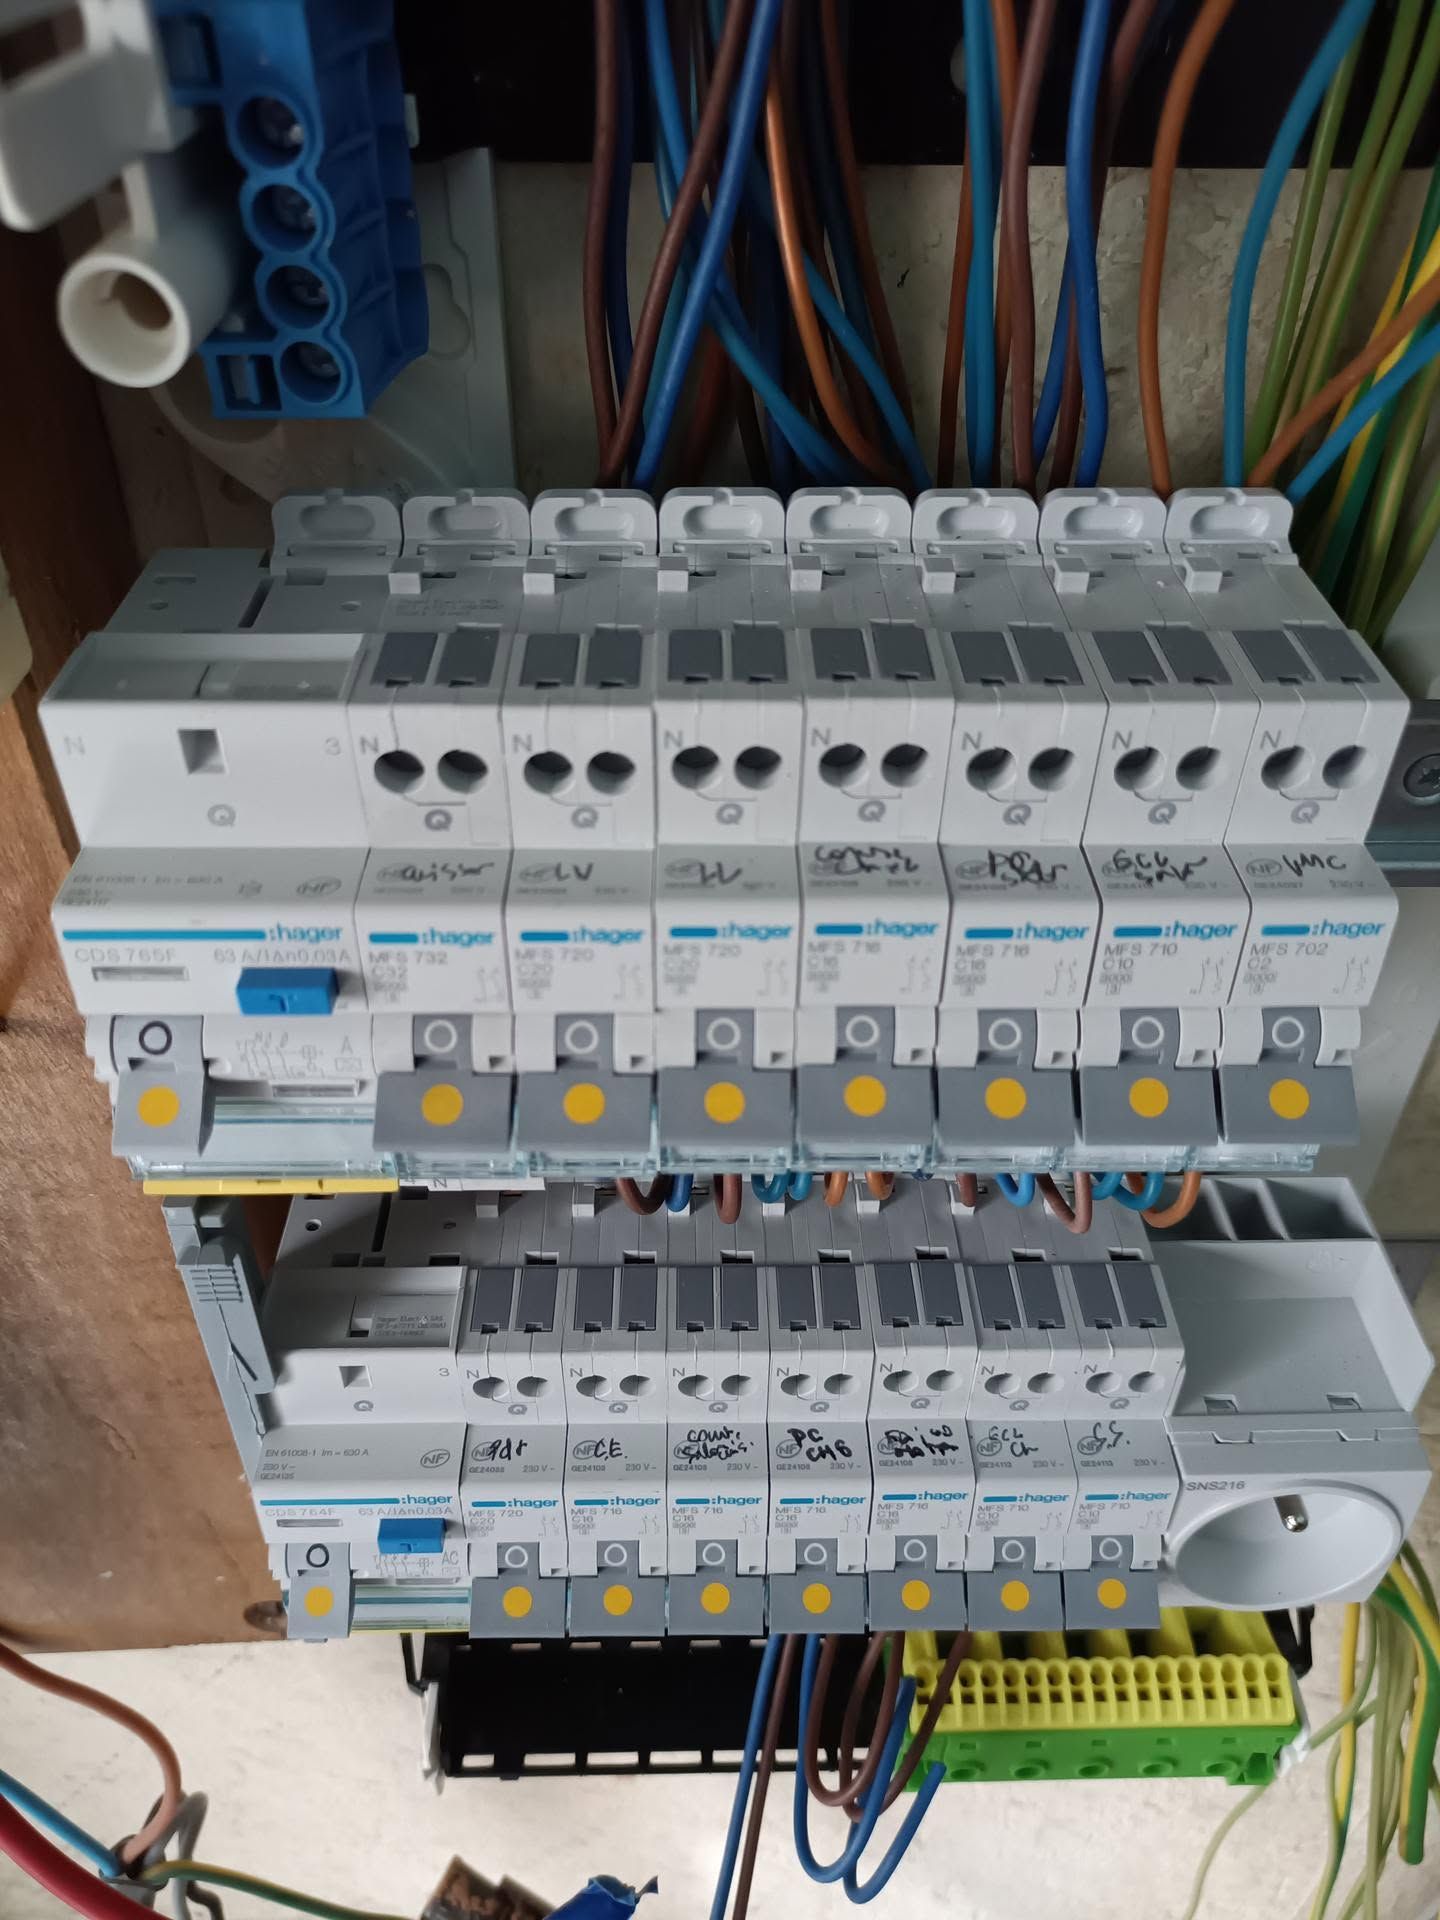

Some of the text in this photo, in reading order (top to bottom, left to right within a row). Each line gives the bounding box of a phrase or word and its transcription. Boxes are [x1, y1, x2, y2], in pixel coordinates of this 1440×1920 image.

[513, 734, 532, 751] N
[664, 730, 683, 748] N
[811, 728, 831, 746] N
[962, 732, 982, 750] N
[1112, 731, 1132, 749] N
[1260, 730, 1281, 749] N
[325, 738, 341, 755] 3
[360, 737, 378, 752] N
[1282, 852, 1346, 877] VMC
[1104, 943, 1178, 956] MFS 710
[1250, 942, 1328, 956] MFS 702
[416, 952, 448, 965] 732
[439, 1368, 450, 1377] 3
[467, 1369, 480, 1379] N
[570, 1367, 583, 1377] N
[673, 1367, 685, 1376] N
[777, 1367, 790, 1376] N
[880, 1363, 893, 1372] N
[981, 1365, 995, 1375] N
[1084, 1364, 1098, 1373] N
[1186, 1481, 1245, 1491] SNS216
[442, 1551, 458, 1565] AC
